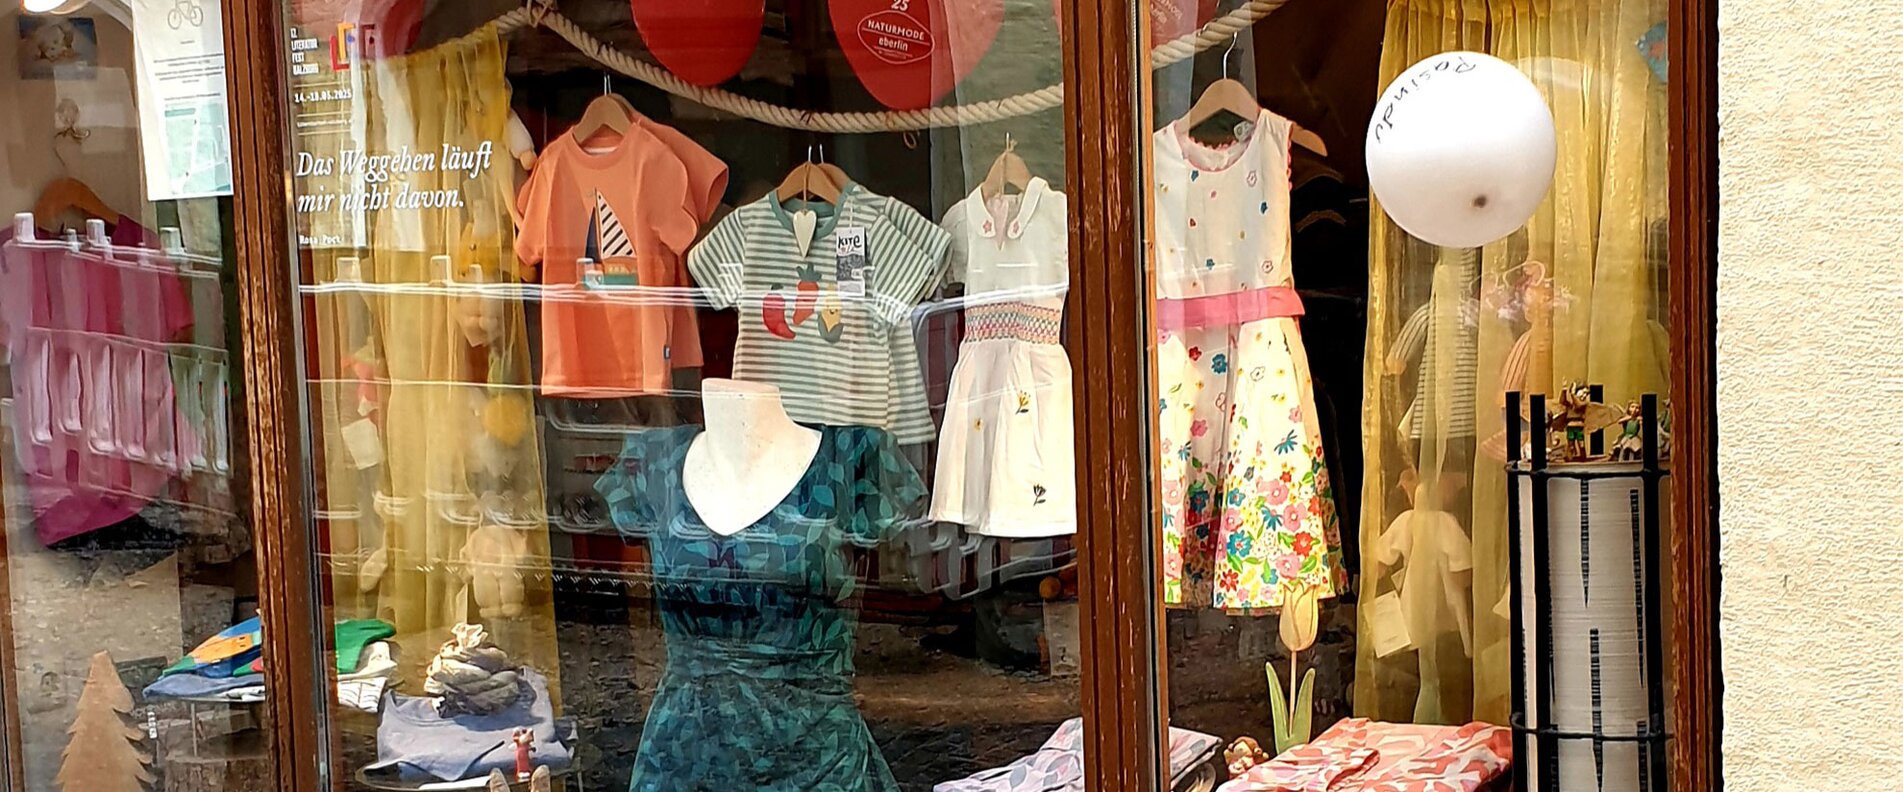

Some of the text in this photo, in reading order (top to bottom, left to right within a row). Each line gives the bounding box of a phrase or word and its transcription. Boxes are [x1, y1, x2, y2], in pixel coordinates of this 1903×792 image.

[891, 0, 909, 11] 25
[867, 19, 925, 41] NATURMODE
[878, 36, 908, 52] eberlin
[292, 51, 305, 64] FEST
[296, 140, 493, 183] Das Weggehen läuft
[298, 183, 464, 213] mir nicht davon.
